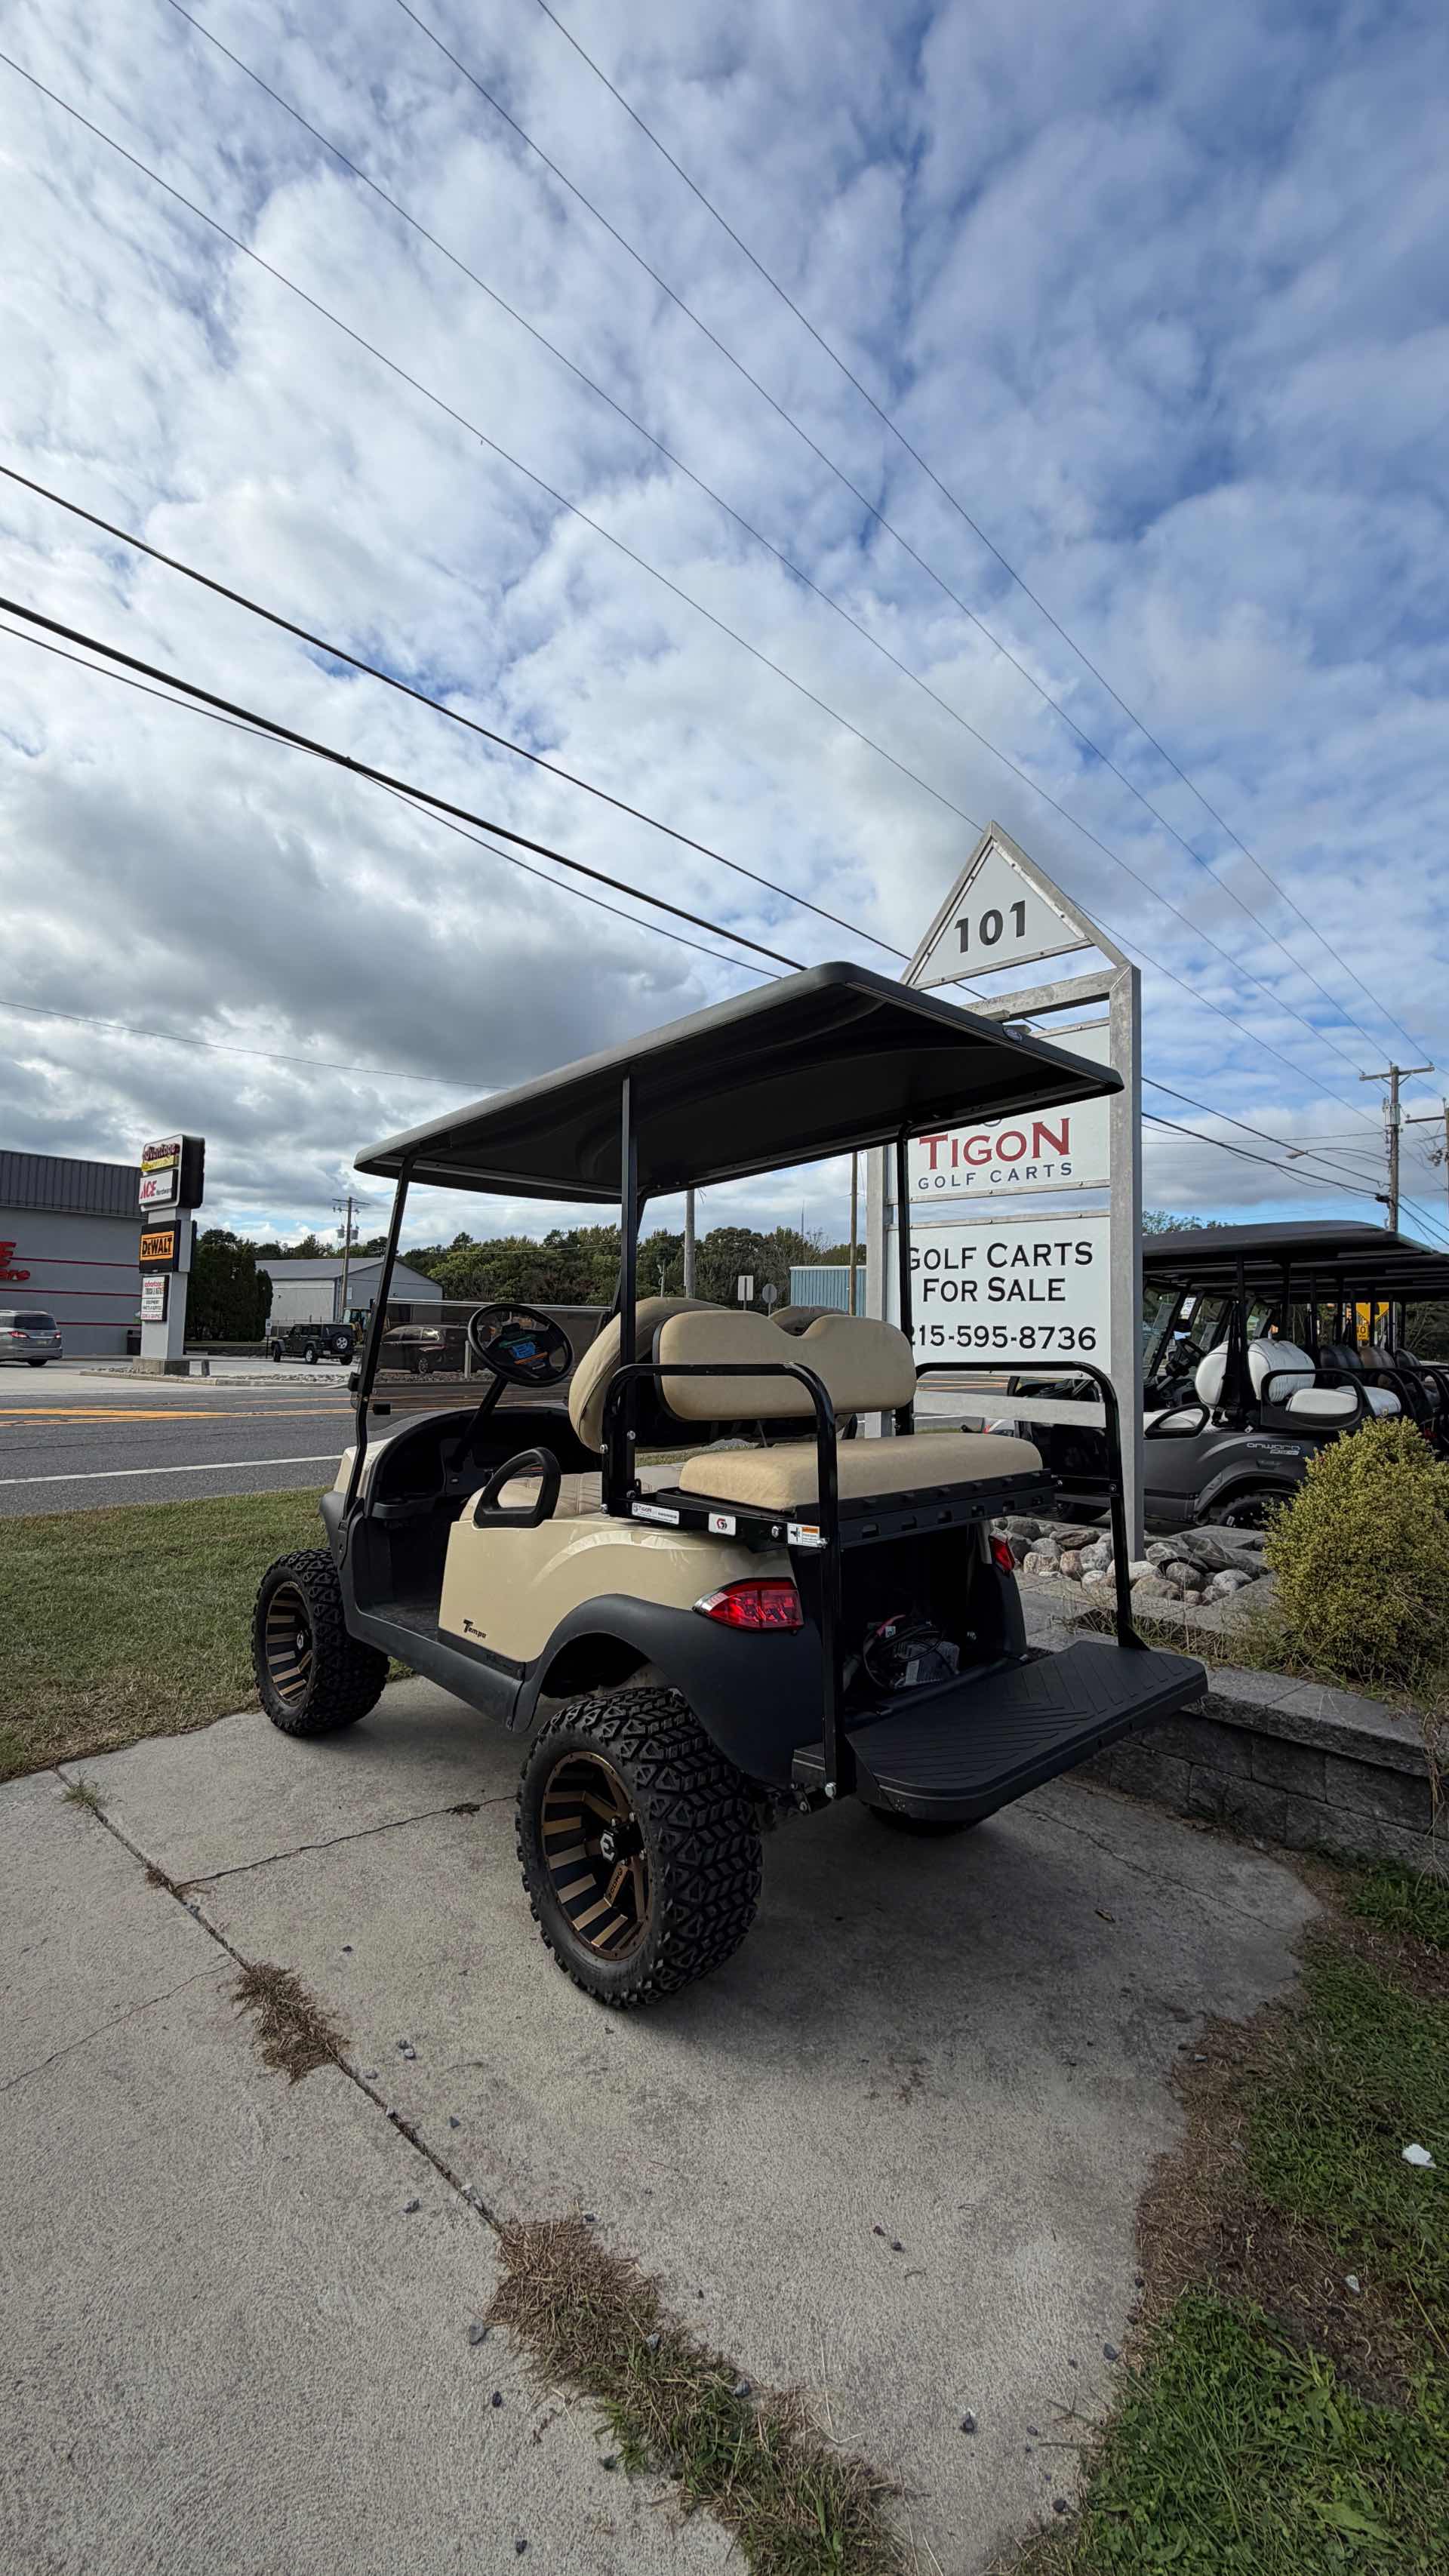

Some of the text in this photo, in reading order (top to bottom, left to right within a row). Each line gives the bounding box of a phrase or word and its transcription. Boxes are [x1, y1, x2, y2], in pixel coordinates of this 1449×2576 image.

[954, 900, 1026, 953] 101
[919, 1117, 1071, 1170] TIGON
[140, 1180, 157, 1199] ACE
[918, 1162, 1072, 1190] GOLF CARTS
[986, 1241, 1094, 1269] CARTS
[922, 1276, 1066, 1303] FOR SALE
[463, 1618, 488, 1639] Tempo
